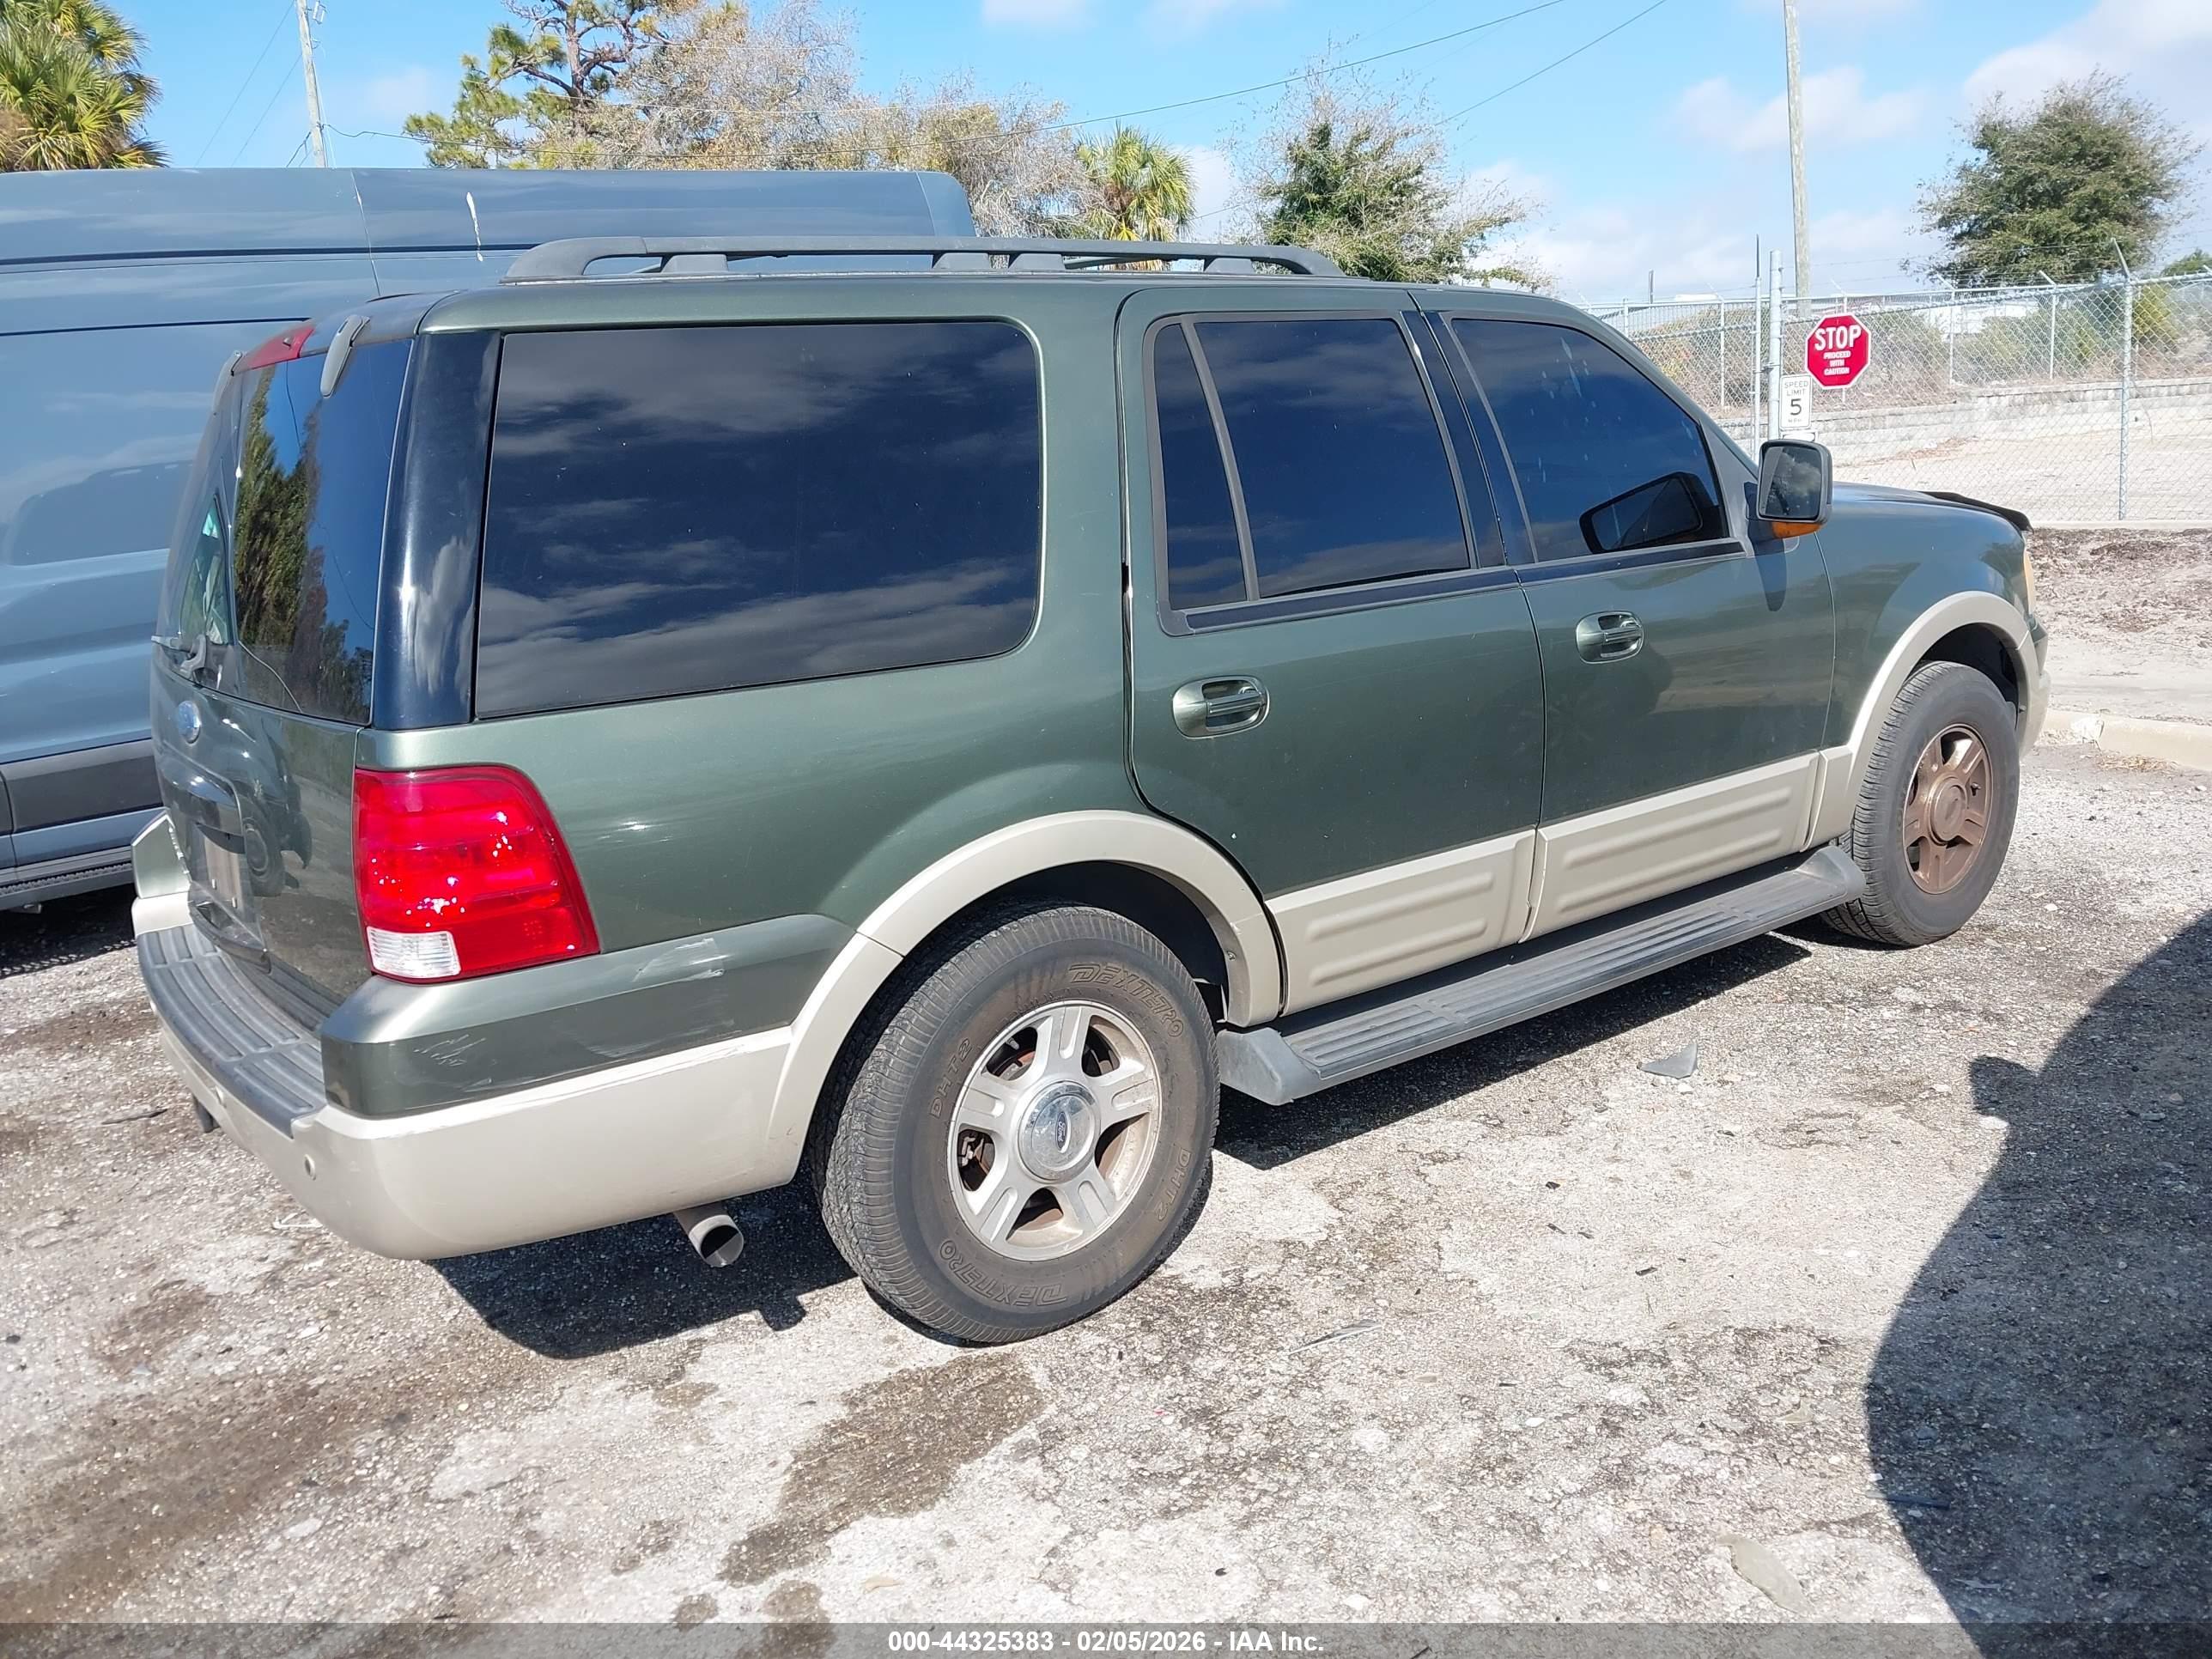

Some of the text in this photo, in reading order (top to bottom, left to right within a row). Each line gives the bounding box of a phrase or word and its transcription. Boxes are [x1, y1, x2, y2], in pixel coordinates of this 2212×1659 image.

[1814, 325, 1862, 351] STOP
[1824, 368, 1850, 376] CAUTION
[1829, 359, 1845, 368] WITH
[1790, 398, 1802, 416] 5
[1068, 963, 1184, 1038] DEXTERO
[929, 1037, 973, 1119] DHT2
[1155, 1147, 1192, 1223] DHT2
[939, 1239, 1068, 1307] DEXTERO
